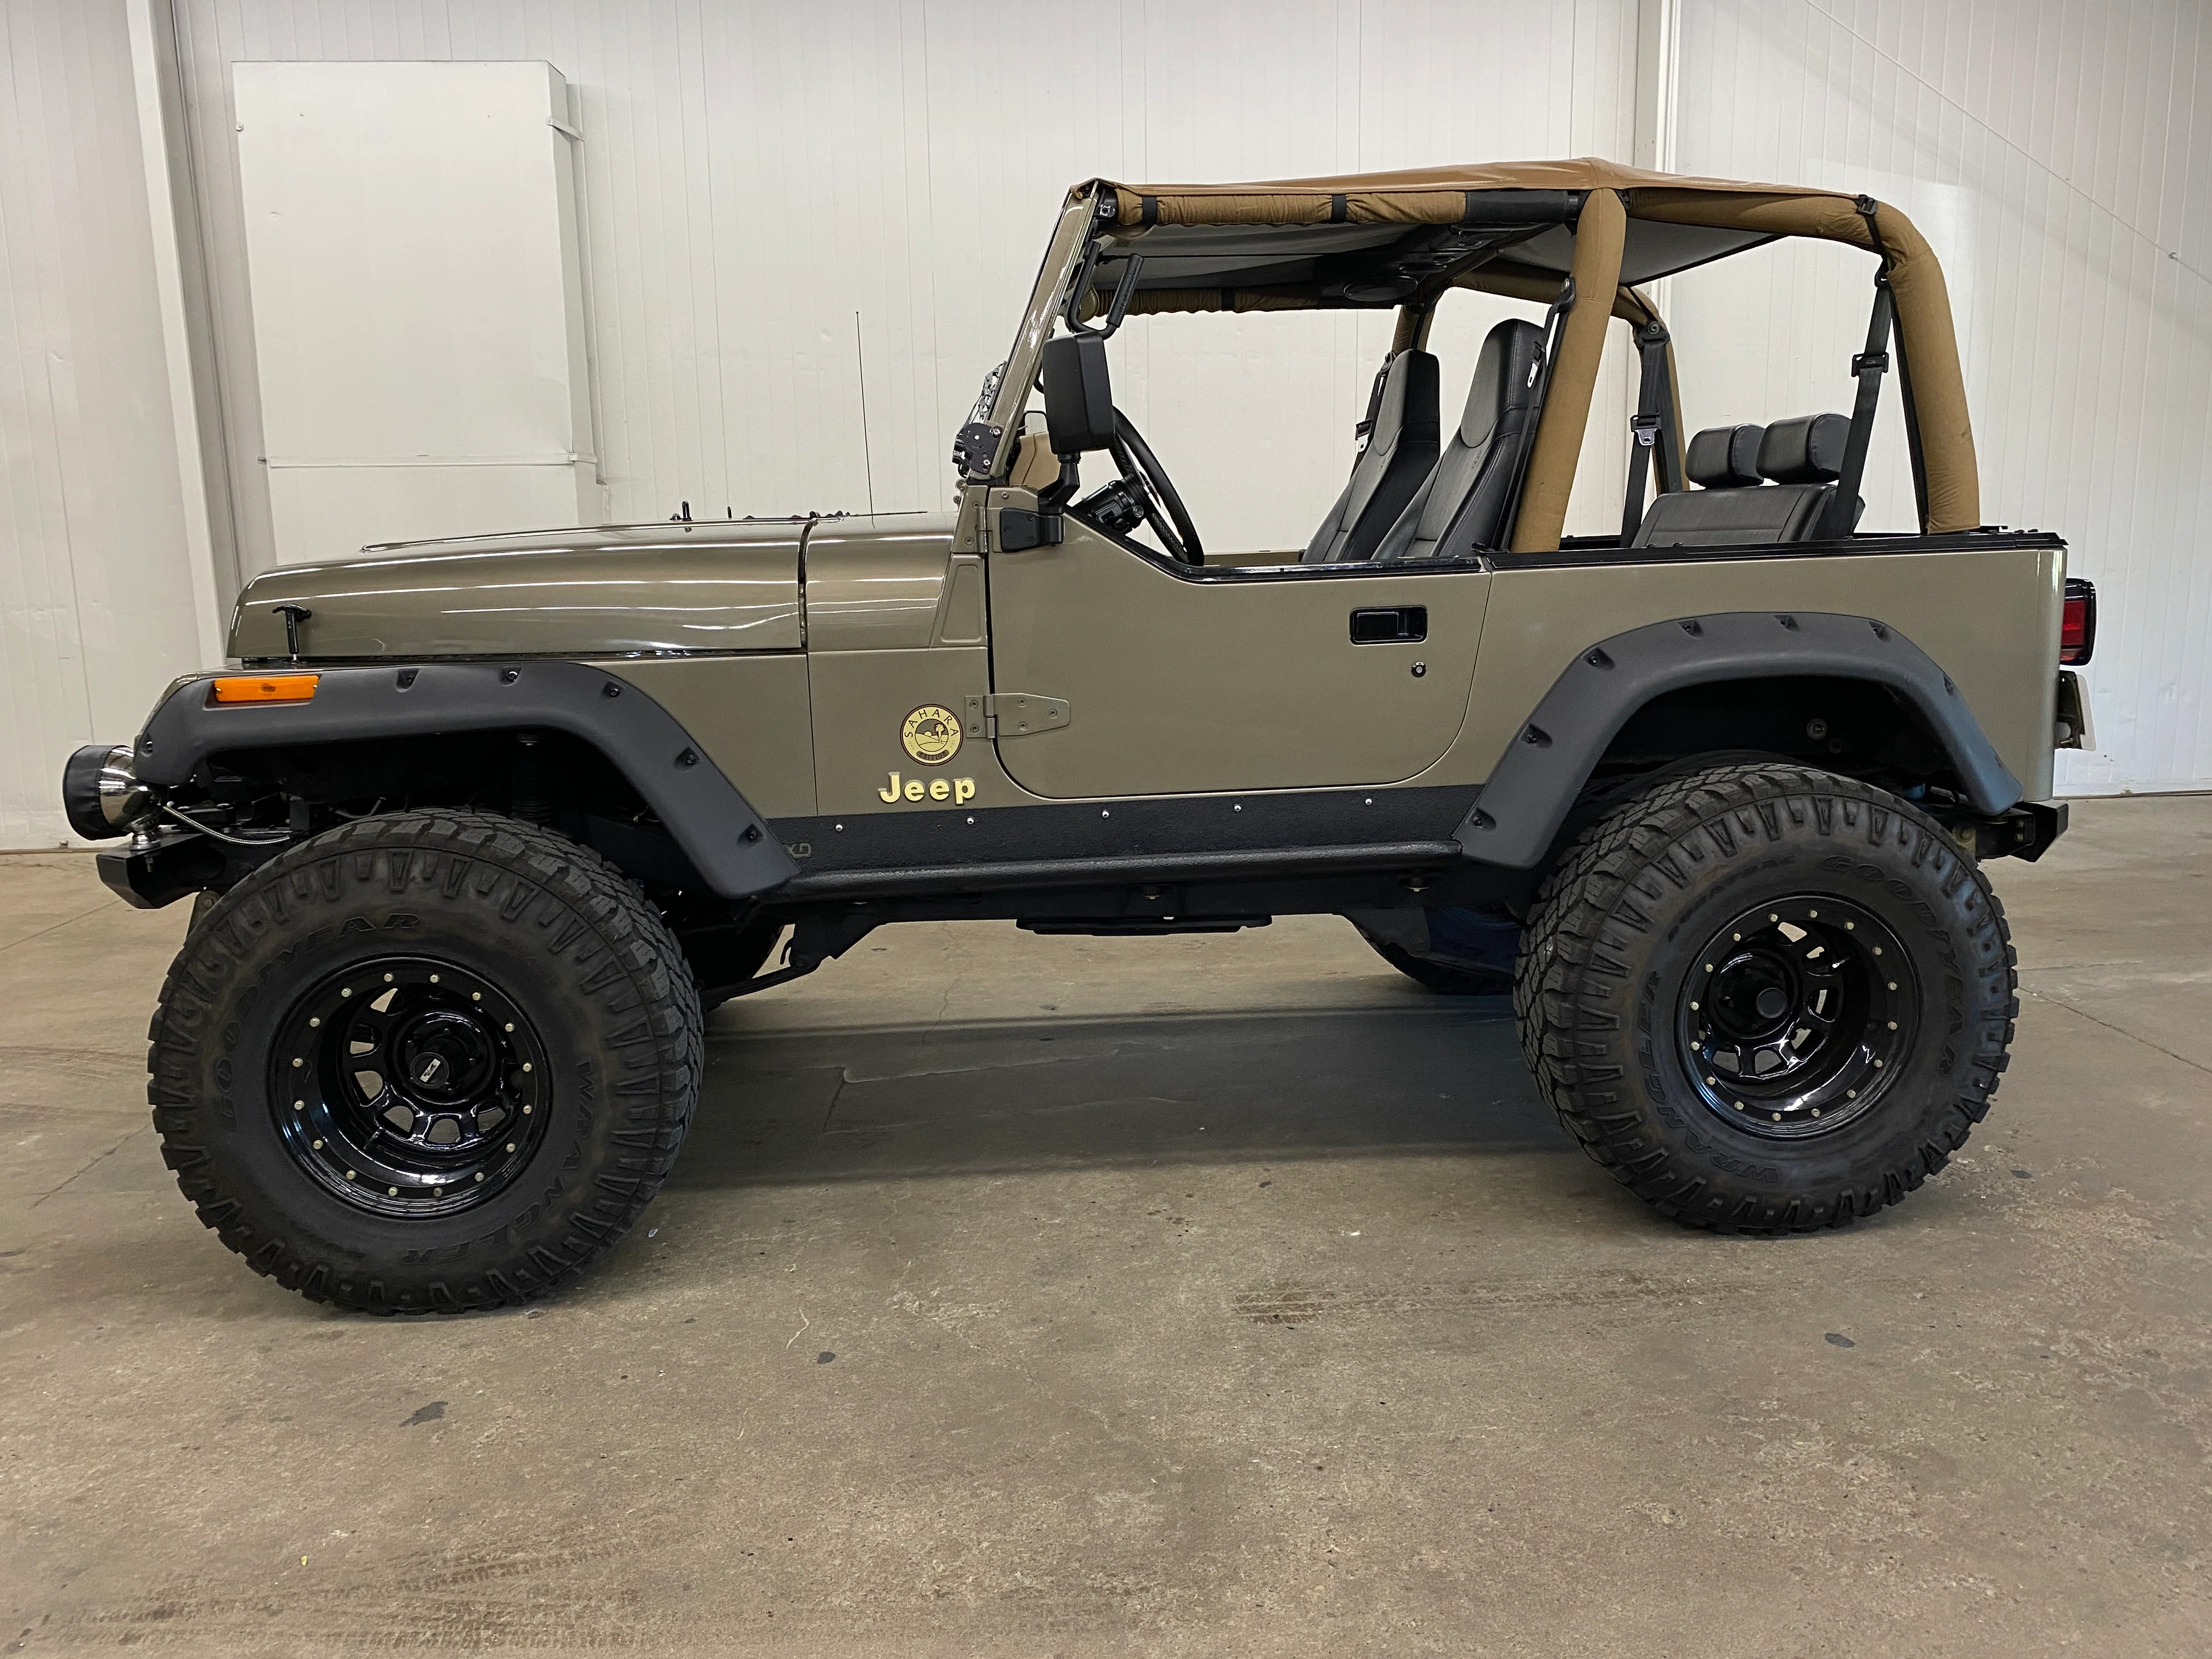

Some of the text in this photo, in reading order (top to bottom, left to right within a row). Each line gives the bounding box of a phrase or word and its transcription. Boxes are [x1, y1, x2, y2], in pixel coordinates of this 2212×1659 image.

[878, 771, 975, 805] Jeep
[904, 709, 959, 737] SAHARA
[918, 751, 947, 760] EDITION
[215, 912, 420, 1132] GOODYEAR
[1820, 855, 1965, 1076] GOODYEAR
[400, 1059, 596, 1266] WRANGLER
[1638, 969, 1779, 1183] WRANGLER
